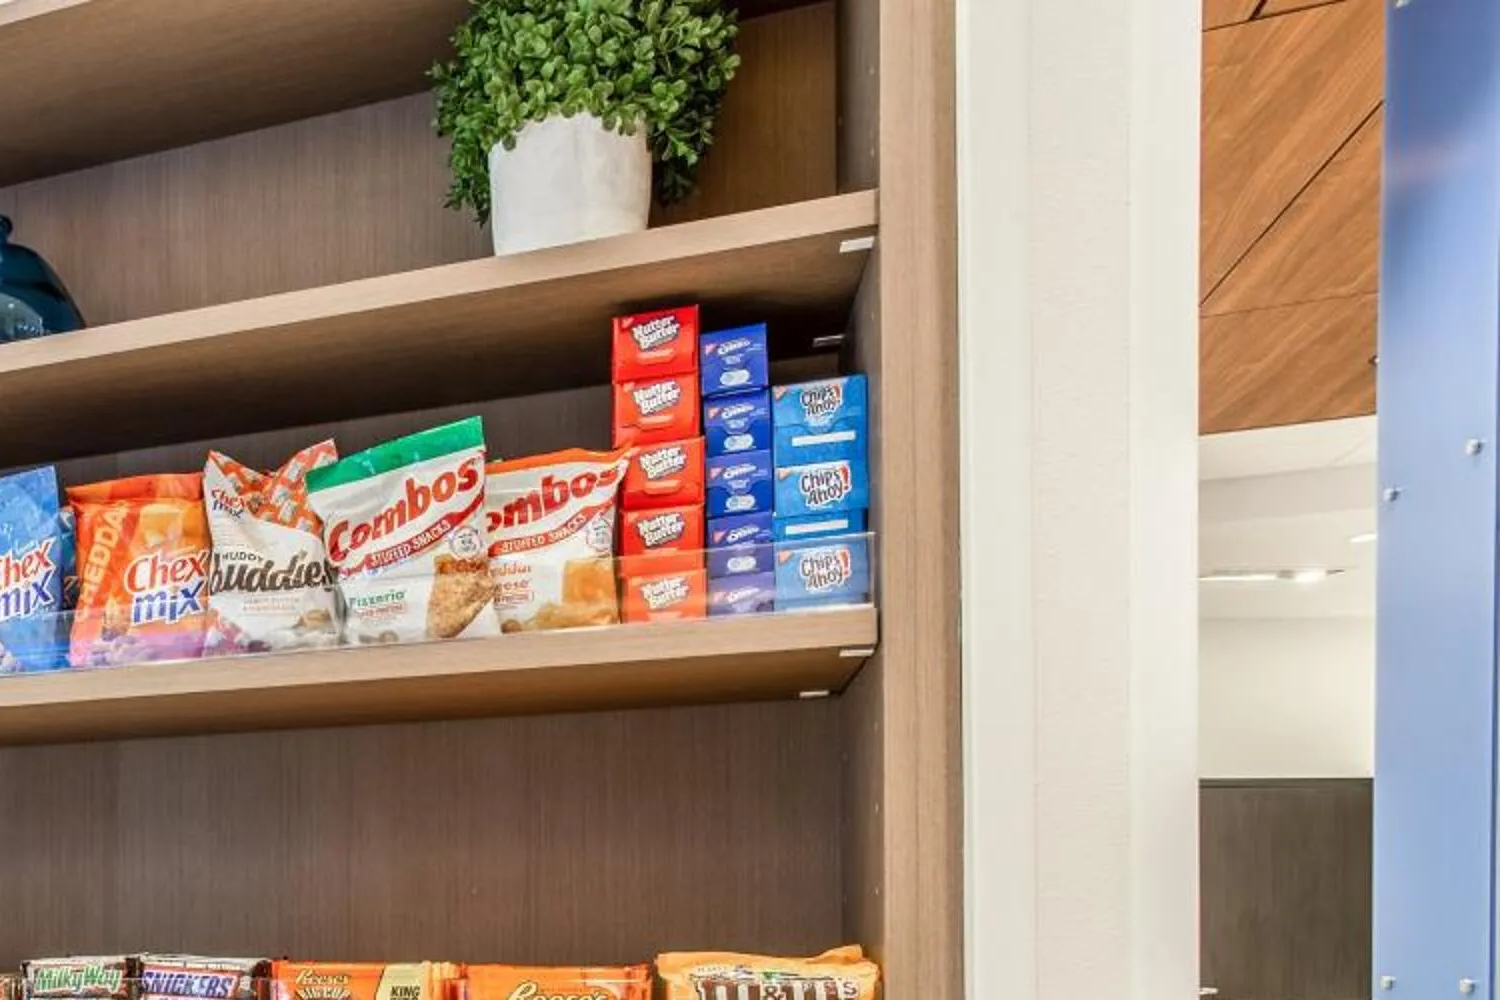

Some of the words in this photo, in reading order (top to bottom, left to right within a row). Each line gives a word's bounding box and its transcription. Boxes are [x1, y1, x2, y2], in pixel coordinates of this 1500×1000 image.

[801, 471, 840, 494] Chips
[327, 457, 480, 562] Combos
[486, 465, 622, 532] ombos
[414, 520, 451, 552] SNACKS
[549, 513, 587, 544] SNACKS
[126, 550, 209, 594] Chex
[801, 557, 840, 580] Chips
[132, 580, 203, 624] mix
[141, 971, 234, 998] SNICKERS
[390, 985, 421, 998] KING
